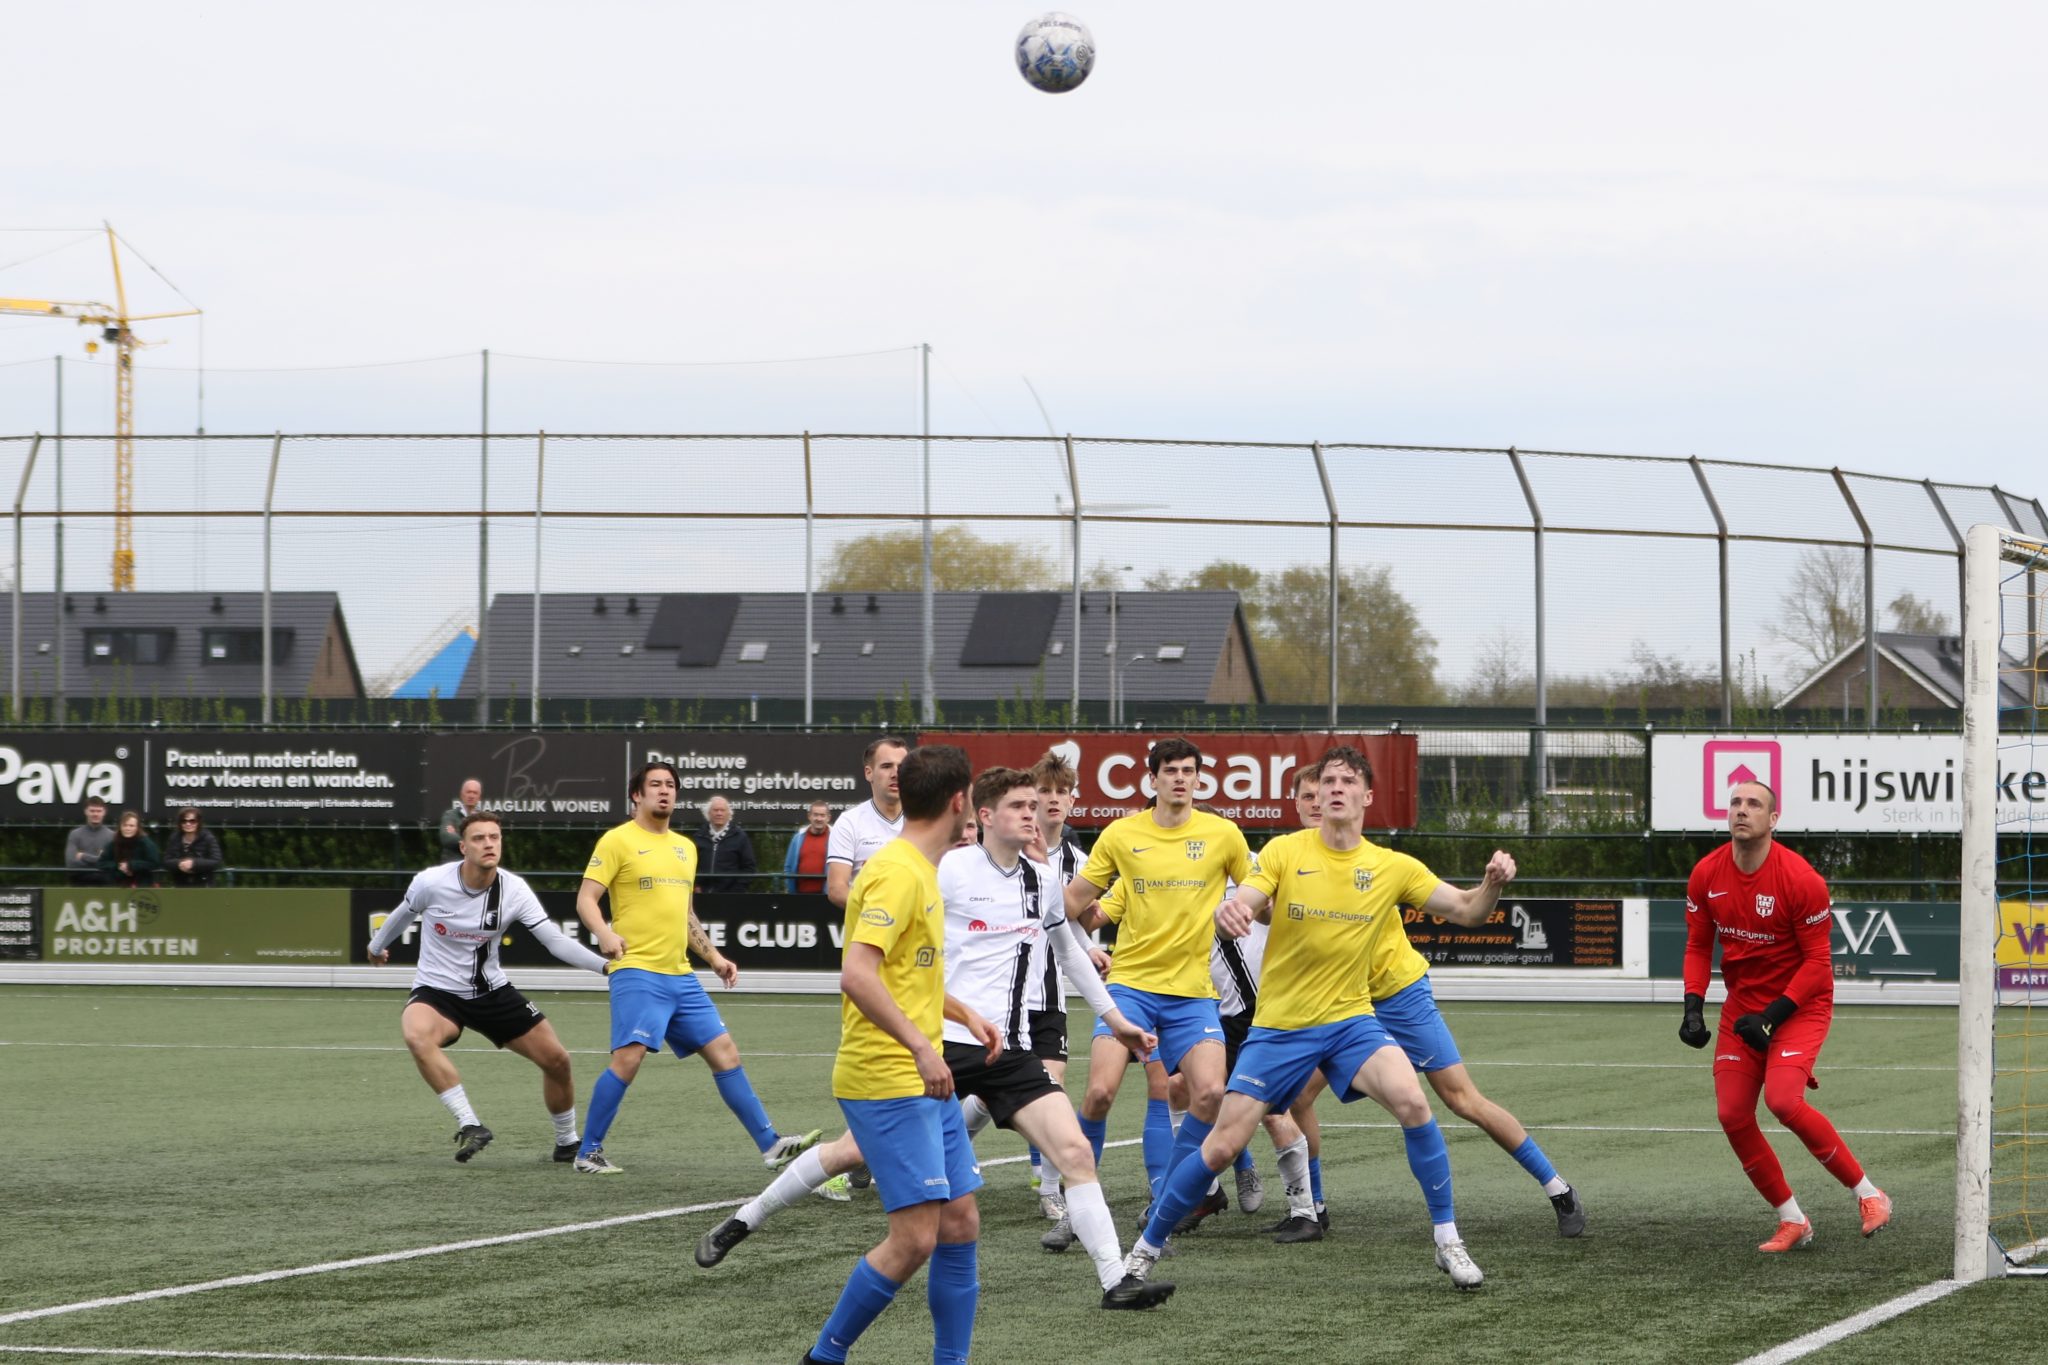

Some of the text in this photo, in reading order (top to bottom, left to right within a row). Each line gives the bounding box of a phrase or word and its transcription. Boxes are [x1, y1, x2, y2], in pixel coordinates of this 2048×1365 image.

[166, 750, 357, 768] Premium materialen
[678, 751, 747, 769] nieuwe
[165, 770, 394, 788] voor vloeren en wanden.
[744, 771, 856, 794] gietvloeren
[165, 799, 191, 807] Direct
[193, 799, 234, 807] leverbaar
[240, 799, 267, 808] Advies
[276, 799, 320, 809] trainingen
[325, 799, 360, 808] Erkende
[361, 799, 394, 808] dealers
[552, 800, 610, 813] WONEN
[748, 801, 780, 810] Perfect
[1243, 806, 1281, 819] data
[1883, 808, 1921, 823] Sterk
[1930, 808, 1944, 823] in
[54, 901, 137, 932] A&H
[1307, 908, 1325, 916] VAN
[1404, 909, 1425, 924] DE
[737, 922, 817, 948] CLUB
[1719, 926, 1735, 934] VAN
[54, 937, 198, 956] PROJEKTEN
[1438, 935, 1450, 944] EN
[1454, 935, 1514, 944] STRAATWERK
[1435, 952, 1447, 961] 47
[1457, 953, 1553, 965] www.gooijer-gsw.nl
